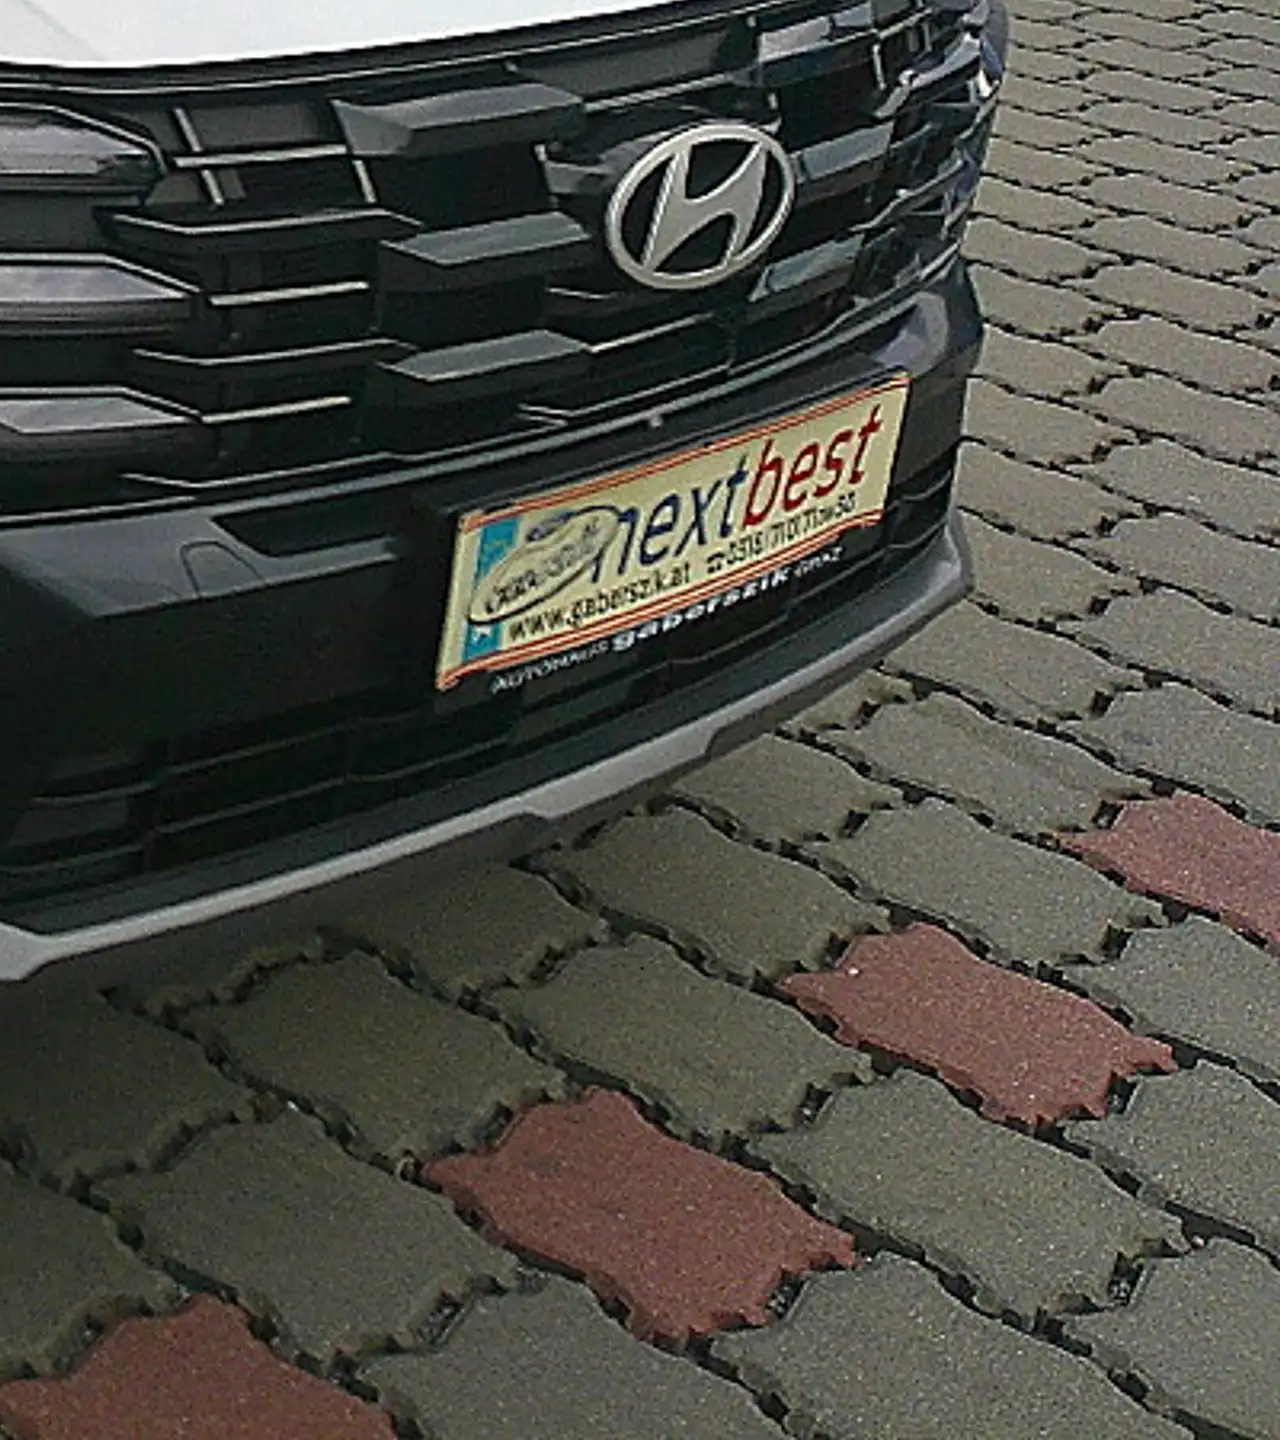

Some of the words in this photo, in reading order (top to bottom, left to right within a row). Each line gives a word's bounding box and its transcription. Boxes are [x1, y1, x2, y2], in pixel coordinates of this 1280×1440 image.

[591, 404, 883, 584] nextbest
[508, 563, 691, 640] www.gaberszik.at
[611, 566, 790, 653] gaberszik
